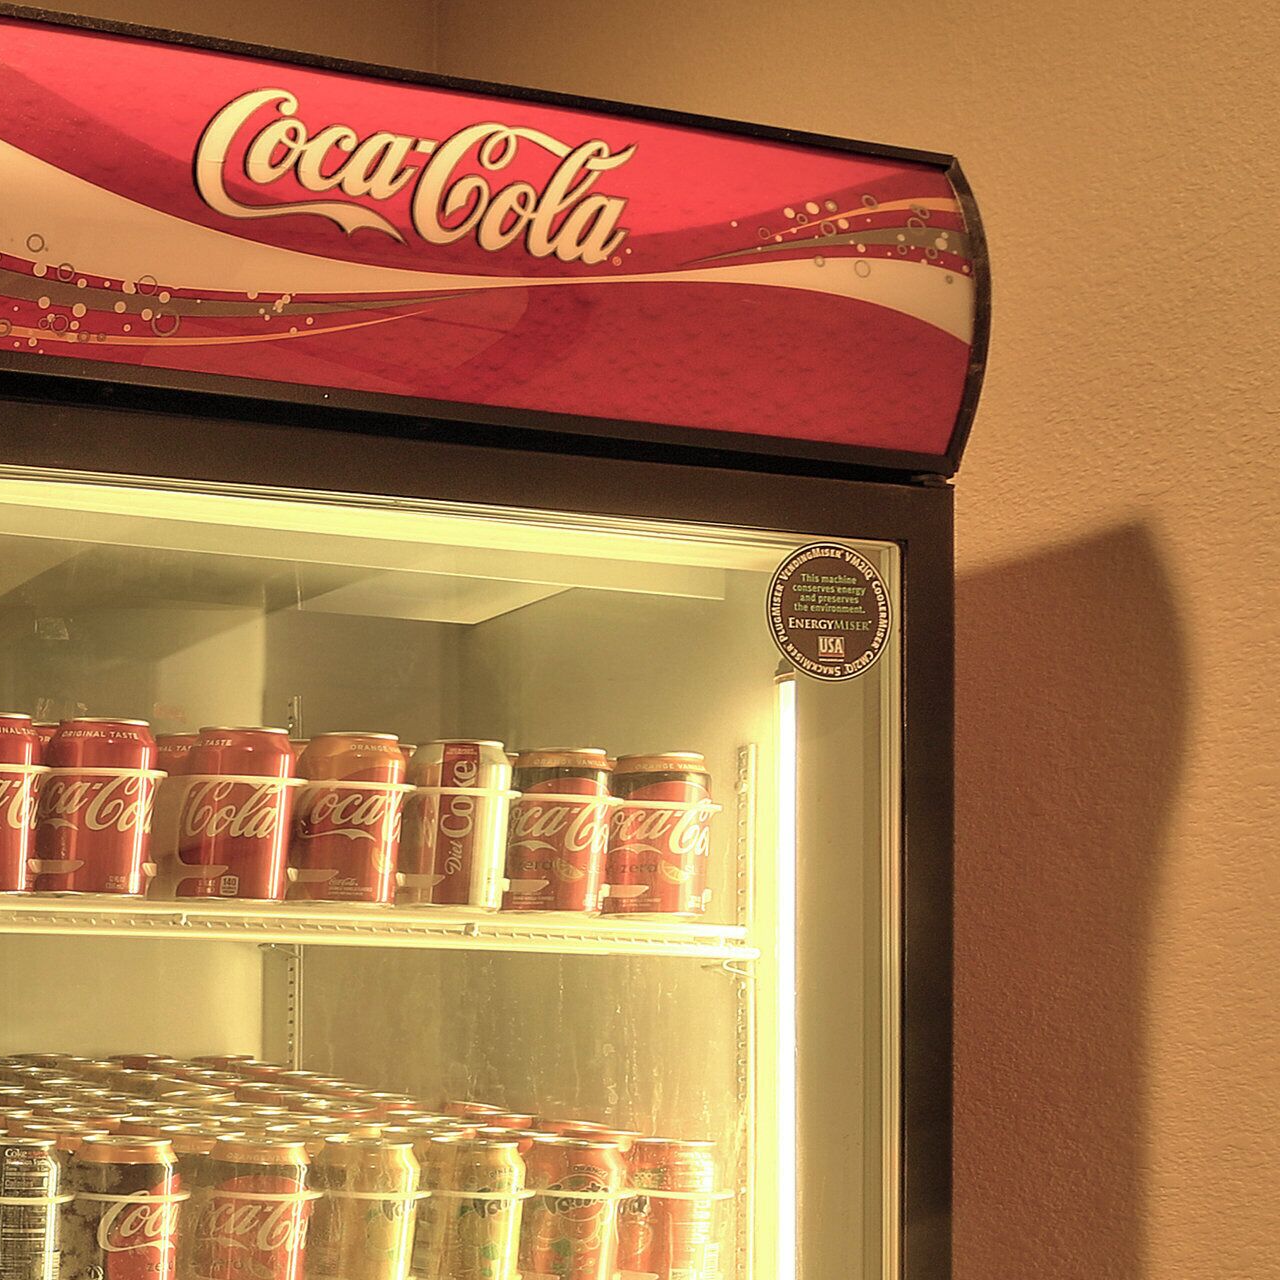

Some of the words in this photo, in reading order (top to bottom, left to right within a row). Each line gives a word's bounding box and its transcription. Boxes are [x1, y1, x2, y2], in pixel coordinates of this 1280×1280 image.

[194, 87, 638, 266] Coca-Cola
[801, 574, 819, 583] This
[821, 575, 857, 584] machine
[792, 585, 835, 593] conserves
[837, 587, 866, 596] energy
[800, 594, 816, 602] and
[818, 595, 859, 604] preserves
[794, 602, 809, 612] the
[820, 638, 843, 653] USA
[62, 730, 105, 739] ORIGINAL
[110, 731, 140, 740] TASTE
[445, 840, 463, 875] Diet
